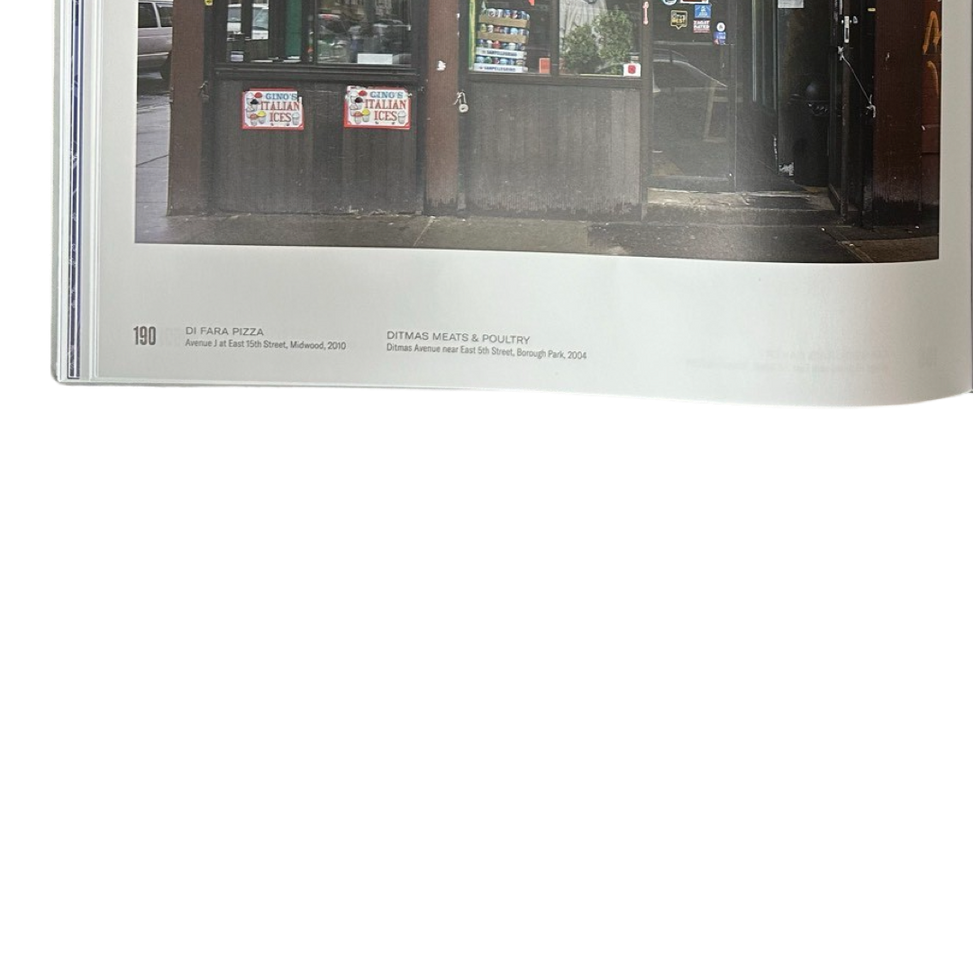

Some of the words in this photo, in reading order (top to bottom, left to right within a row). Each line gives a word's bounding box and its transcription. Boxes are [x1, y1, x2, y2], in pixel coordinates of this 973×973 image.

[369, 91, 404, 99] GINO'S
[260, 101, 300, 111] ITALIAN
[364, 99, 406, 110] ITALIAN
[269, 112, 292, 122] ICES
[374, 110, 397, 121] ICES
[133, 326, 157, 346] 190
[185, 326, 197, 335] DI
[200, 327, 229, 336] FARA
[232, 328, 264, 336] PIZZA
[386, 331, 429, 341] DITMAS
[432, 332, 469, 342] MEATS
[471, 334, 479, 343] &
[482, 334, 530, 345] POULTRY
[185, 339, 212, 347] Avenue
[213, 339, 218, 348] J
[229, 339, 245, 347] East
[246, 340, 262, 348] 15th
[263, 340, 288, 350] Street,
[290, 341, 327, 351] Midwood,
[327, 342, 347, 350] 2010
[386, 343, 412, 352] Ditmas
[414, 344, 441, 353] Avenue
[442, 346, 458, 354] near
[460, 345, 476, 355] East
[477, 346, 490, 355] 5th
[491, 347, 515, 357] Street,
[517, 348, 546, 360] Borough
[548, 349, 566, 360] Park,
[567, 350, 587, 360] 2004
